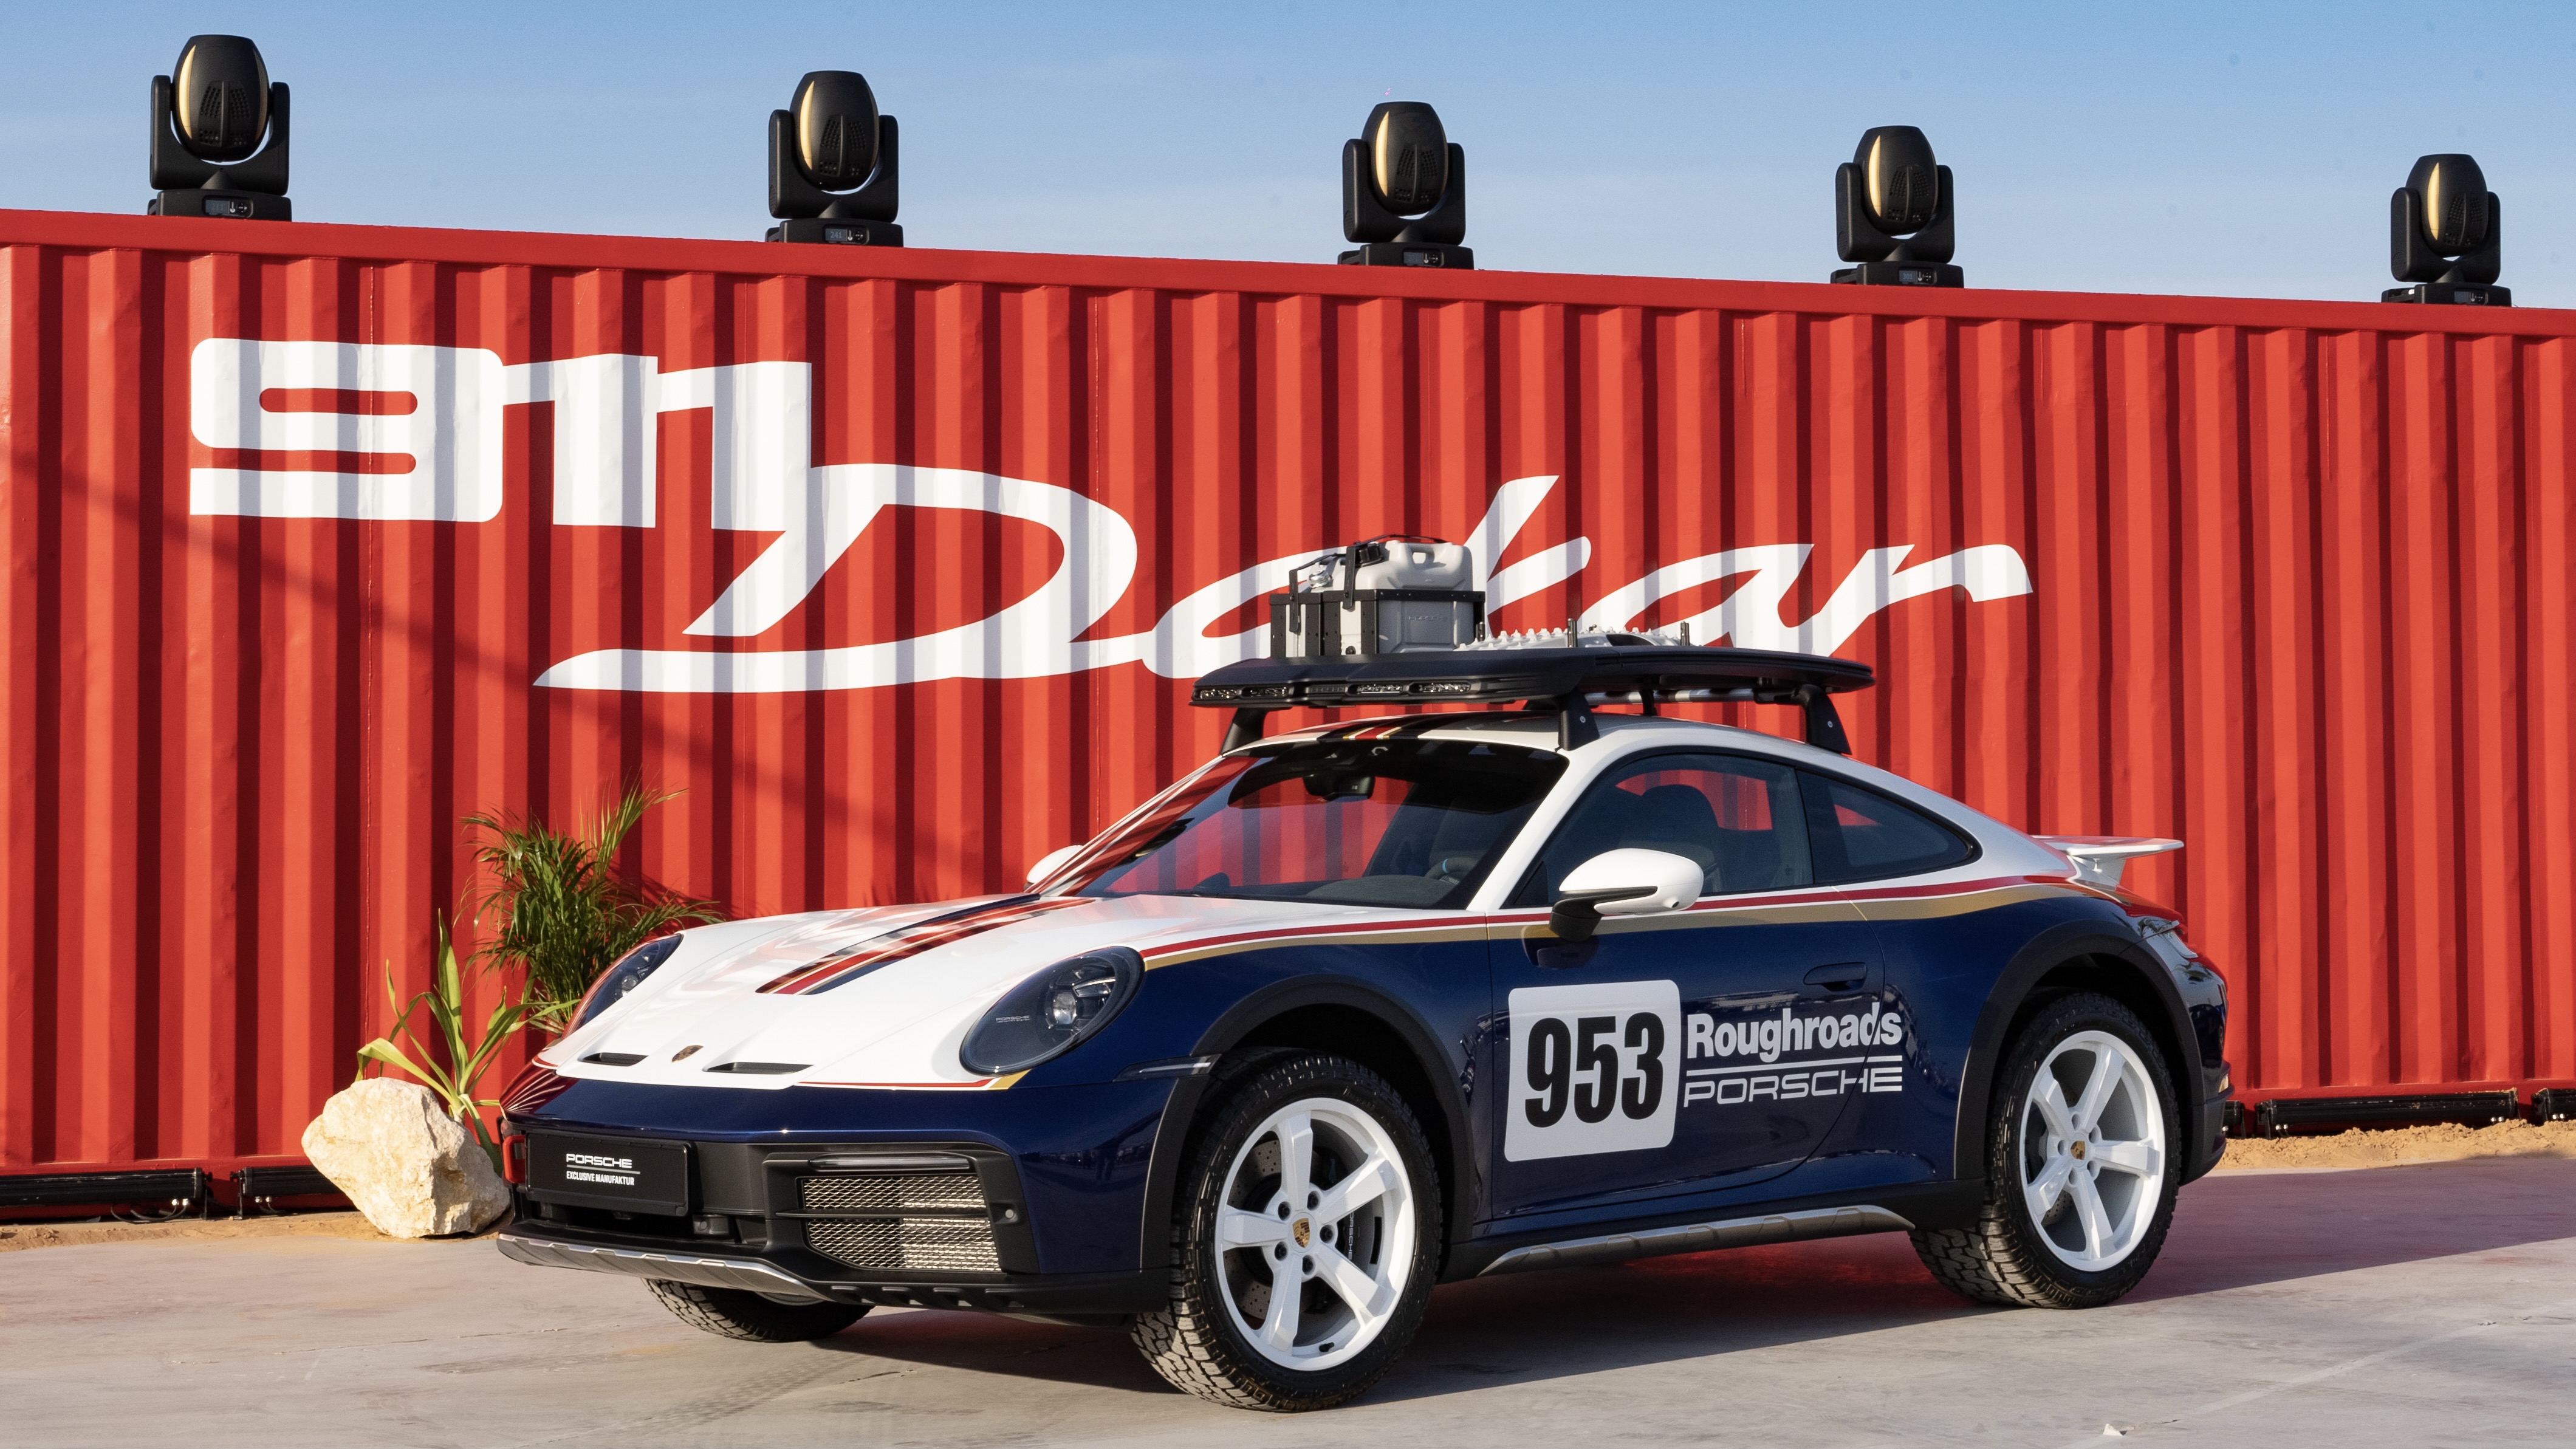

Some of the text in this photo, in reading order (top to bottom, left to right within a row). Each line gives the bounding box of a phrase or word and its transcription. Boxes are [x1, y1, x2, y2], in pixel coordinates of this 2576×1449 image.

[190, 338, 811, 531] 911
[533, 464, 2033, 693] Dakar
[1687, 1001, 1902, 1063] Roughroads
[1525, 1012, 1665, 1128] 953
[1684, 1067, 1902, 1108] PORSCHE
[566, 1153, 632, 1169] PORSCHE
[566, 1171, 595, 1182] EXCLUSIVE
[595, 1173, 635, 1186] MANUFAKTUR
